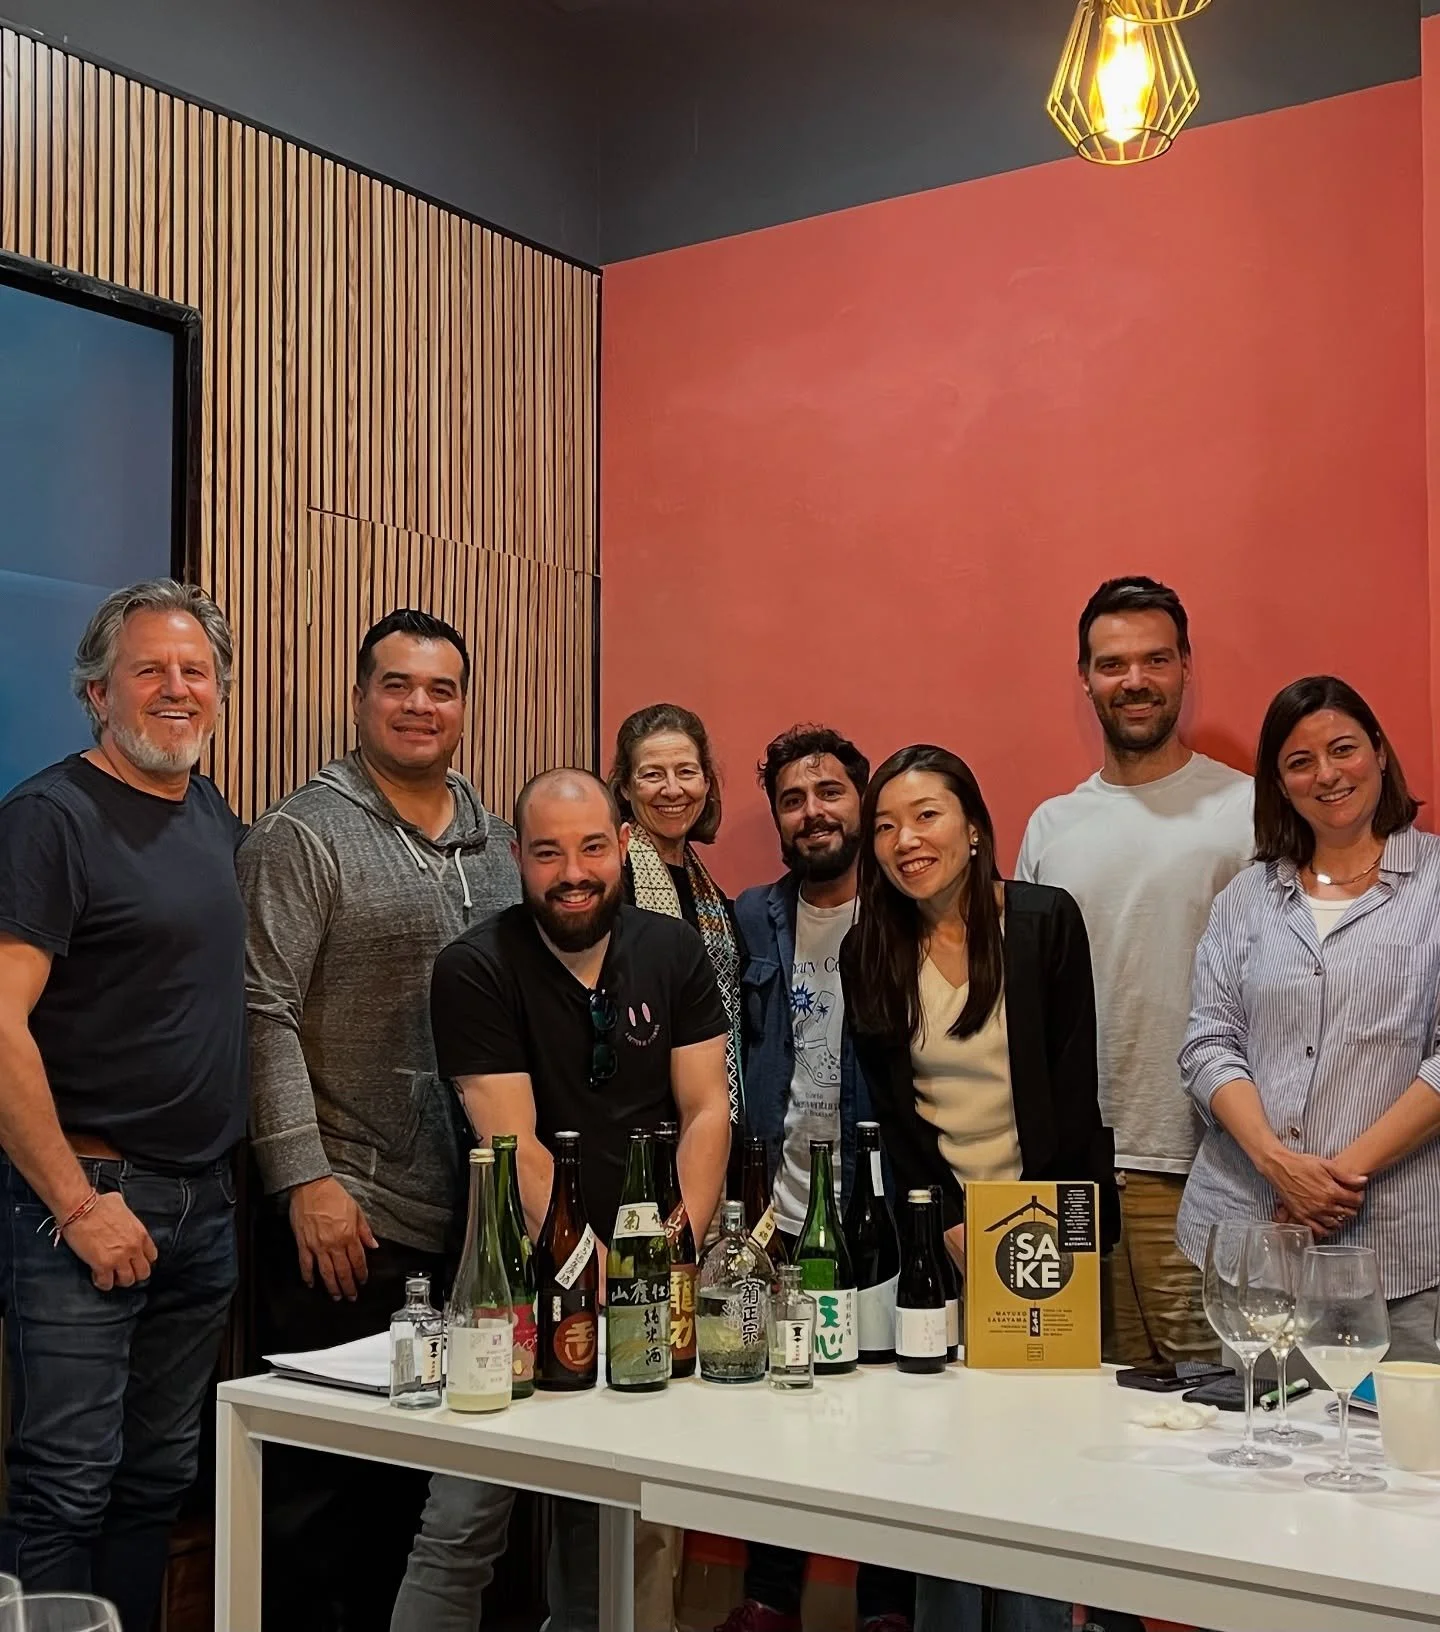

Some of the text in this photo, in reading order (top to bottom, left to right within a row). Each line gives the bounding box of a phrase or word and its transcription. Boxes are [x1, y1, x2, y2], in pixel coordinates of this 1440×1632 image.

[1016, 1232, 1061, 1261] SA
[1016, 1261, 1061, 1289] KE
[644, 1306, 662, 1367] 純米酒
[742, 1282, 760, 1348] 菊正宗
